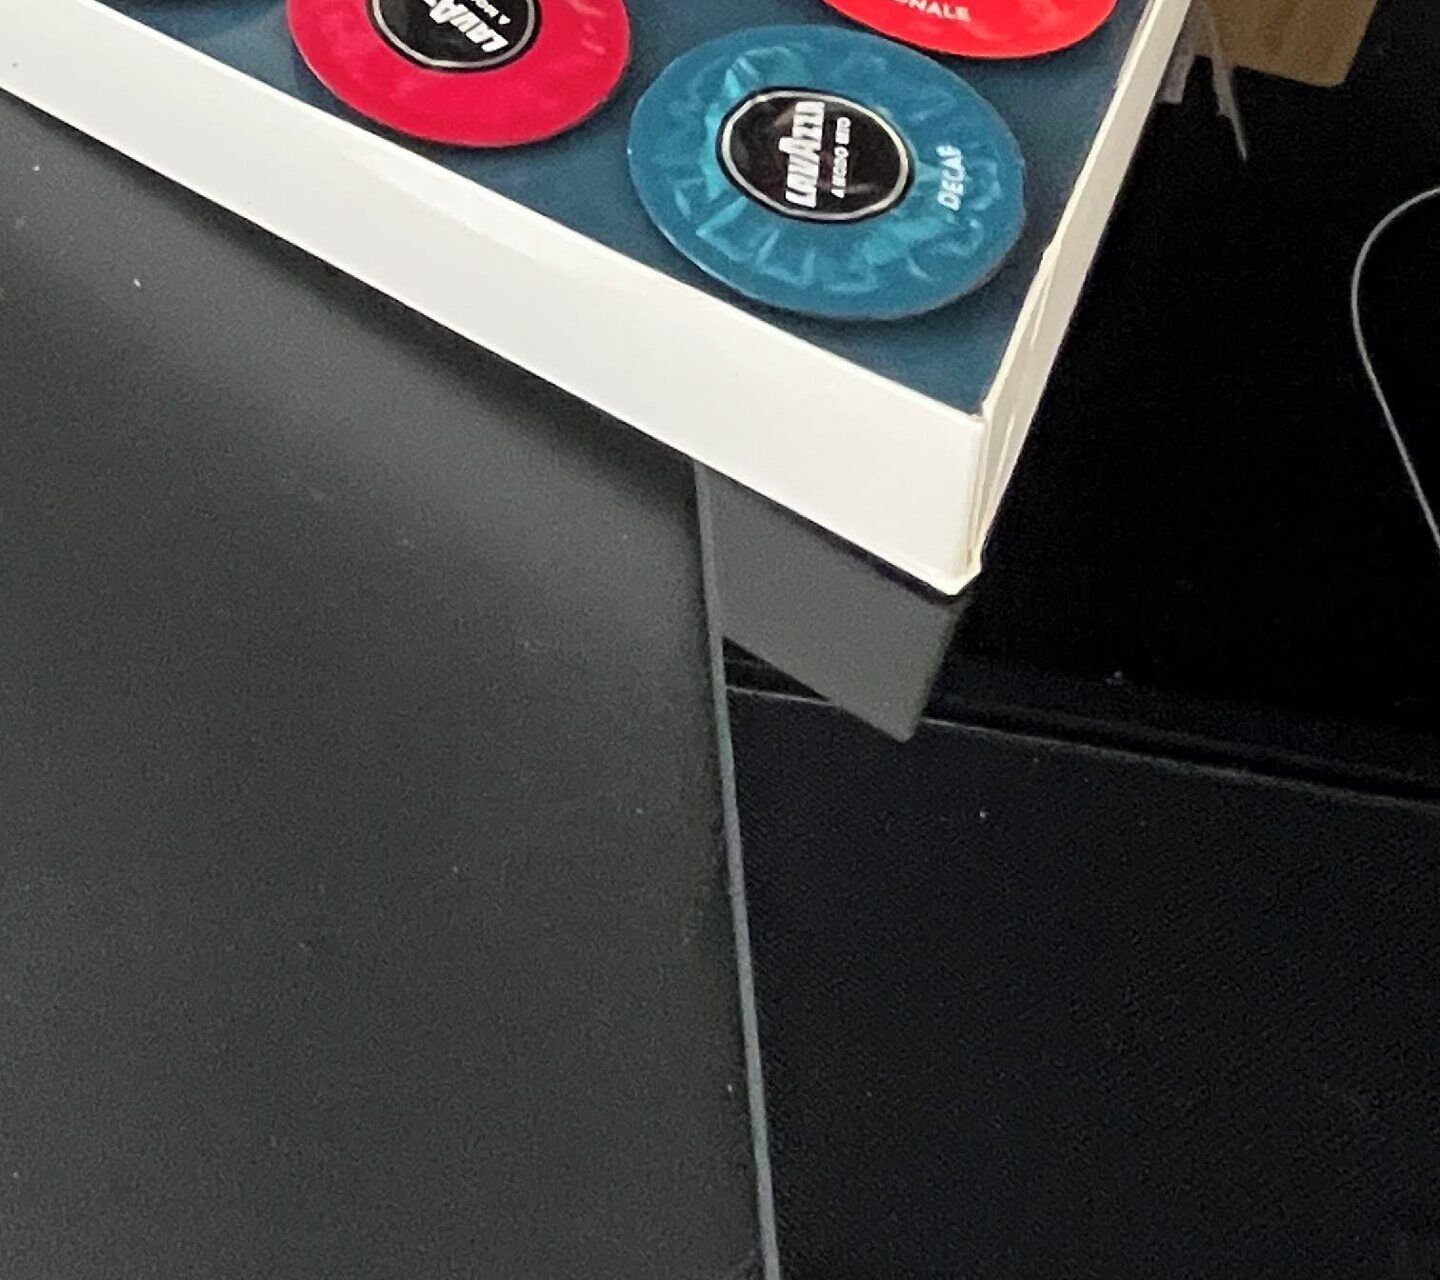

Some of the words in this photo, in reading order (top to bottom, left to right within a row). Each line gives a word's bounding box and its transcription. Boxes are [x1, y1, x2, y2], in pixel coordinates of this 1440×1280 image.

[497, 14, 512, 26] A
[834, 116, 852, 146] MIO
[777, 100, 826, 209] LAVAZZA
[830, 146, 850, 189] MODO
[829, 187, 847, 199] A
[936, 144, 964, 212] DECAF
